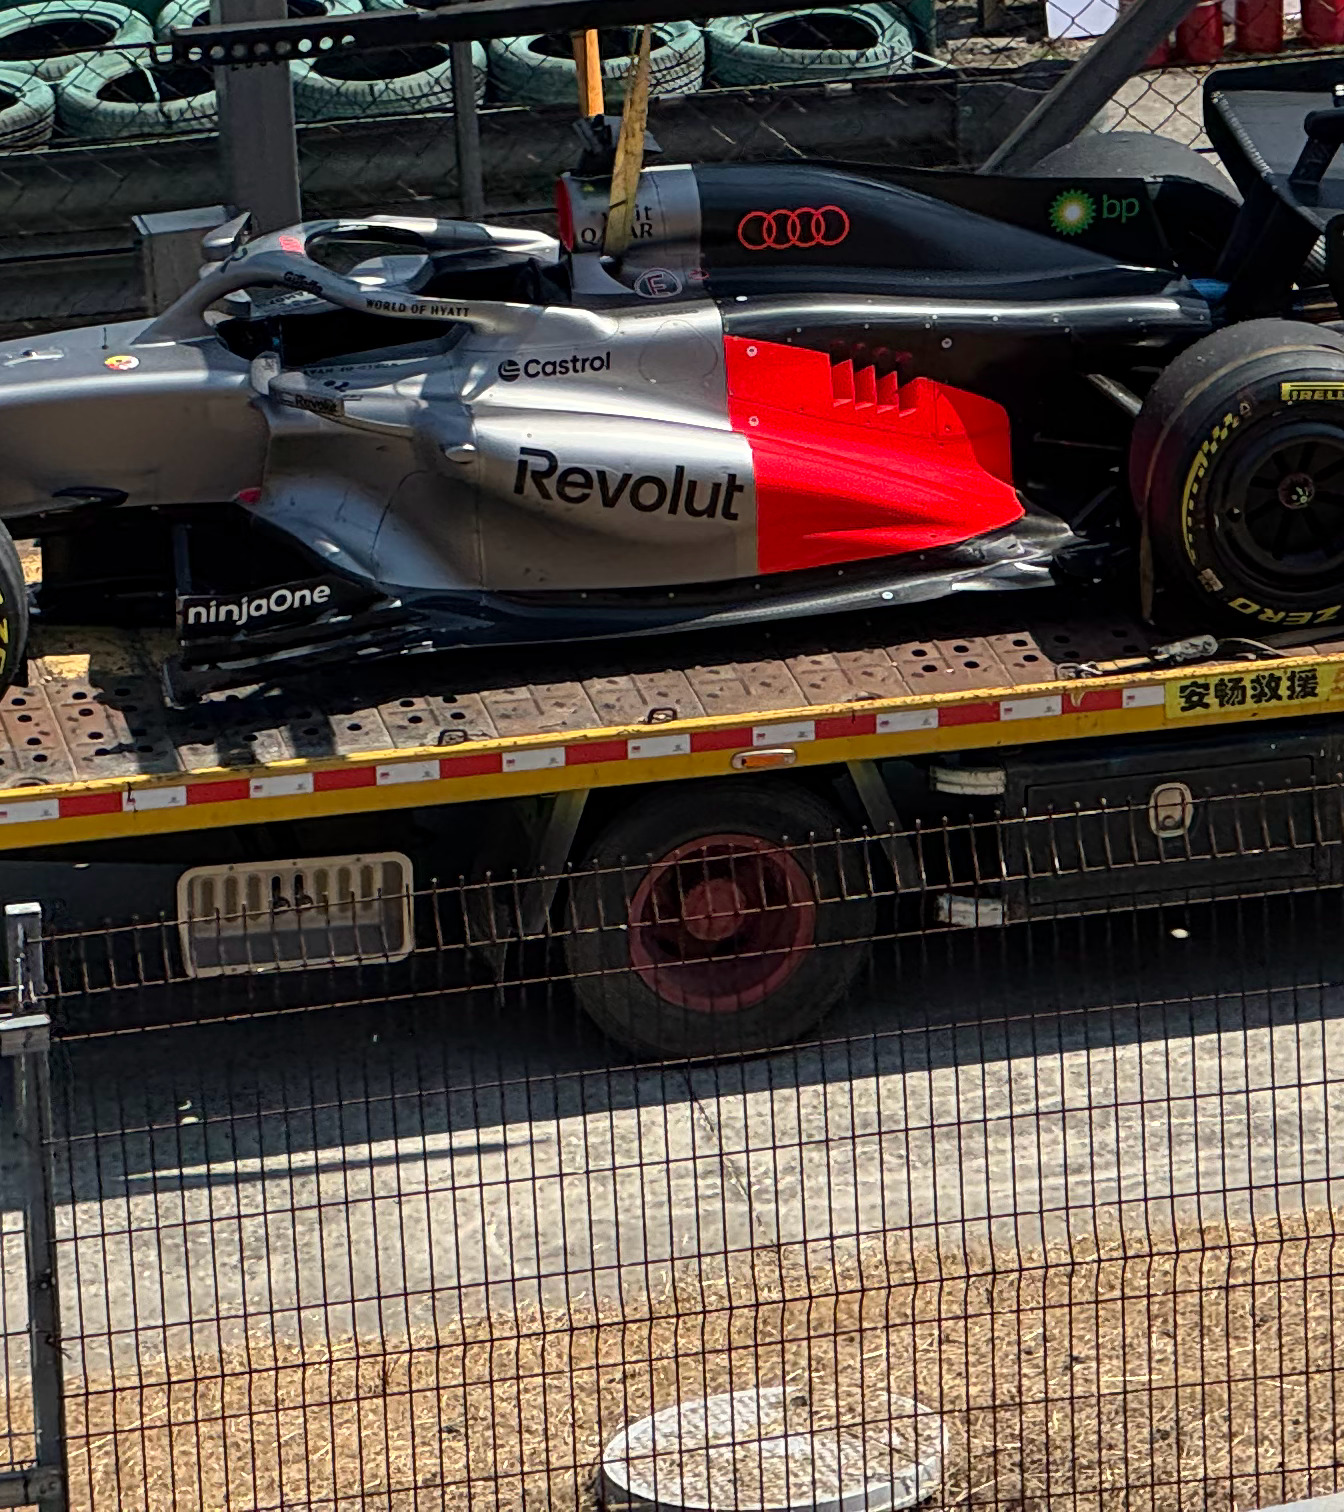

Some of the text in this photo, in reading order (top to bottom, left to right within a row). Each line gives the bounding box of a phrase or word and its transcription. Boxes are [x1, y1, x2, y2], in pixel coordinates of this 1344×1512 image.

[1102, 194, 1140, 223] bp
[366, 299, 471, 318] WORLD OF HYATT
[524, 351, 611, 379] Castrol
[513, 446, 745, 522] Revolut
[187, 584, 330, 626] ninjaOne
[1228, 597, 1342, 626] ZERO
[1179, 669, 1319, 712] 安畅救援
